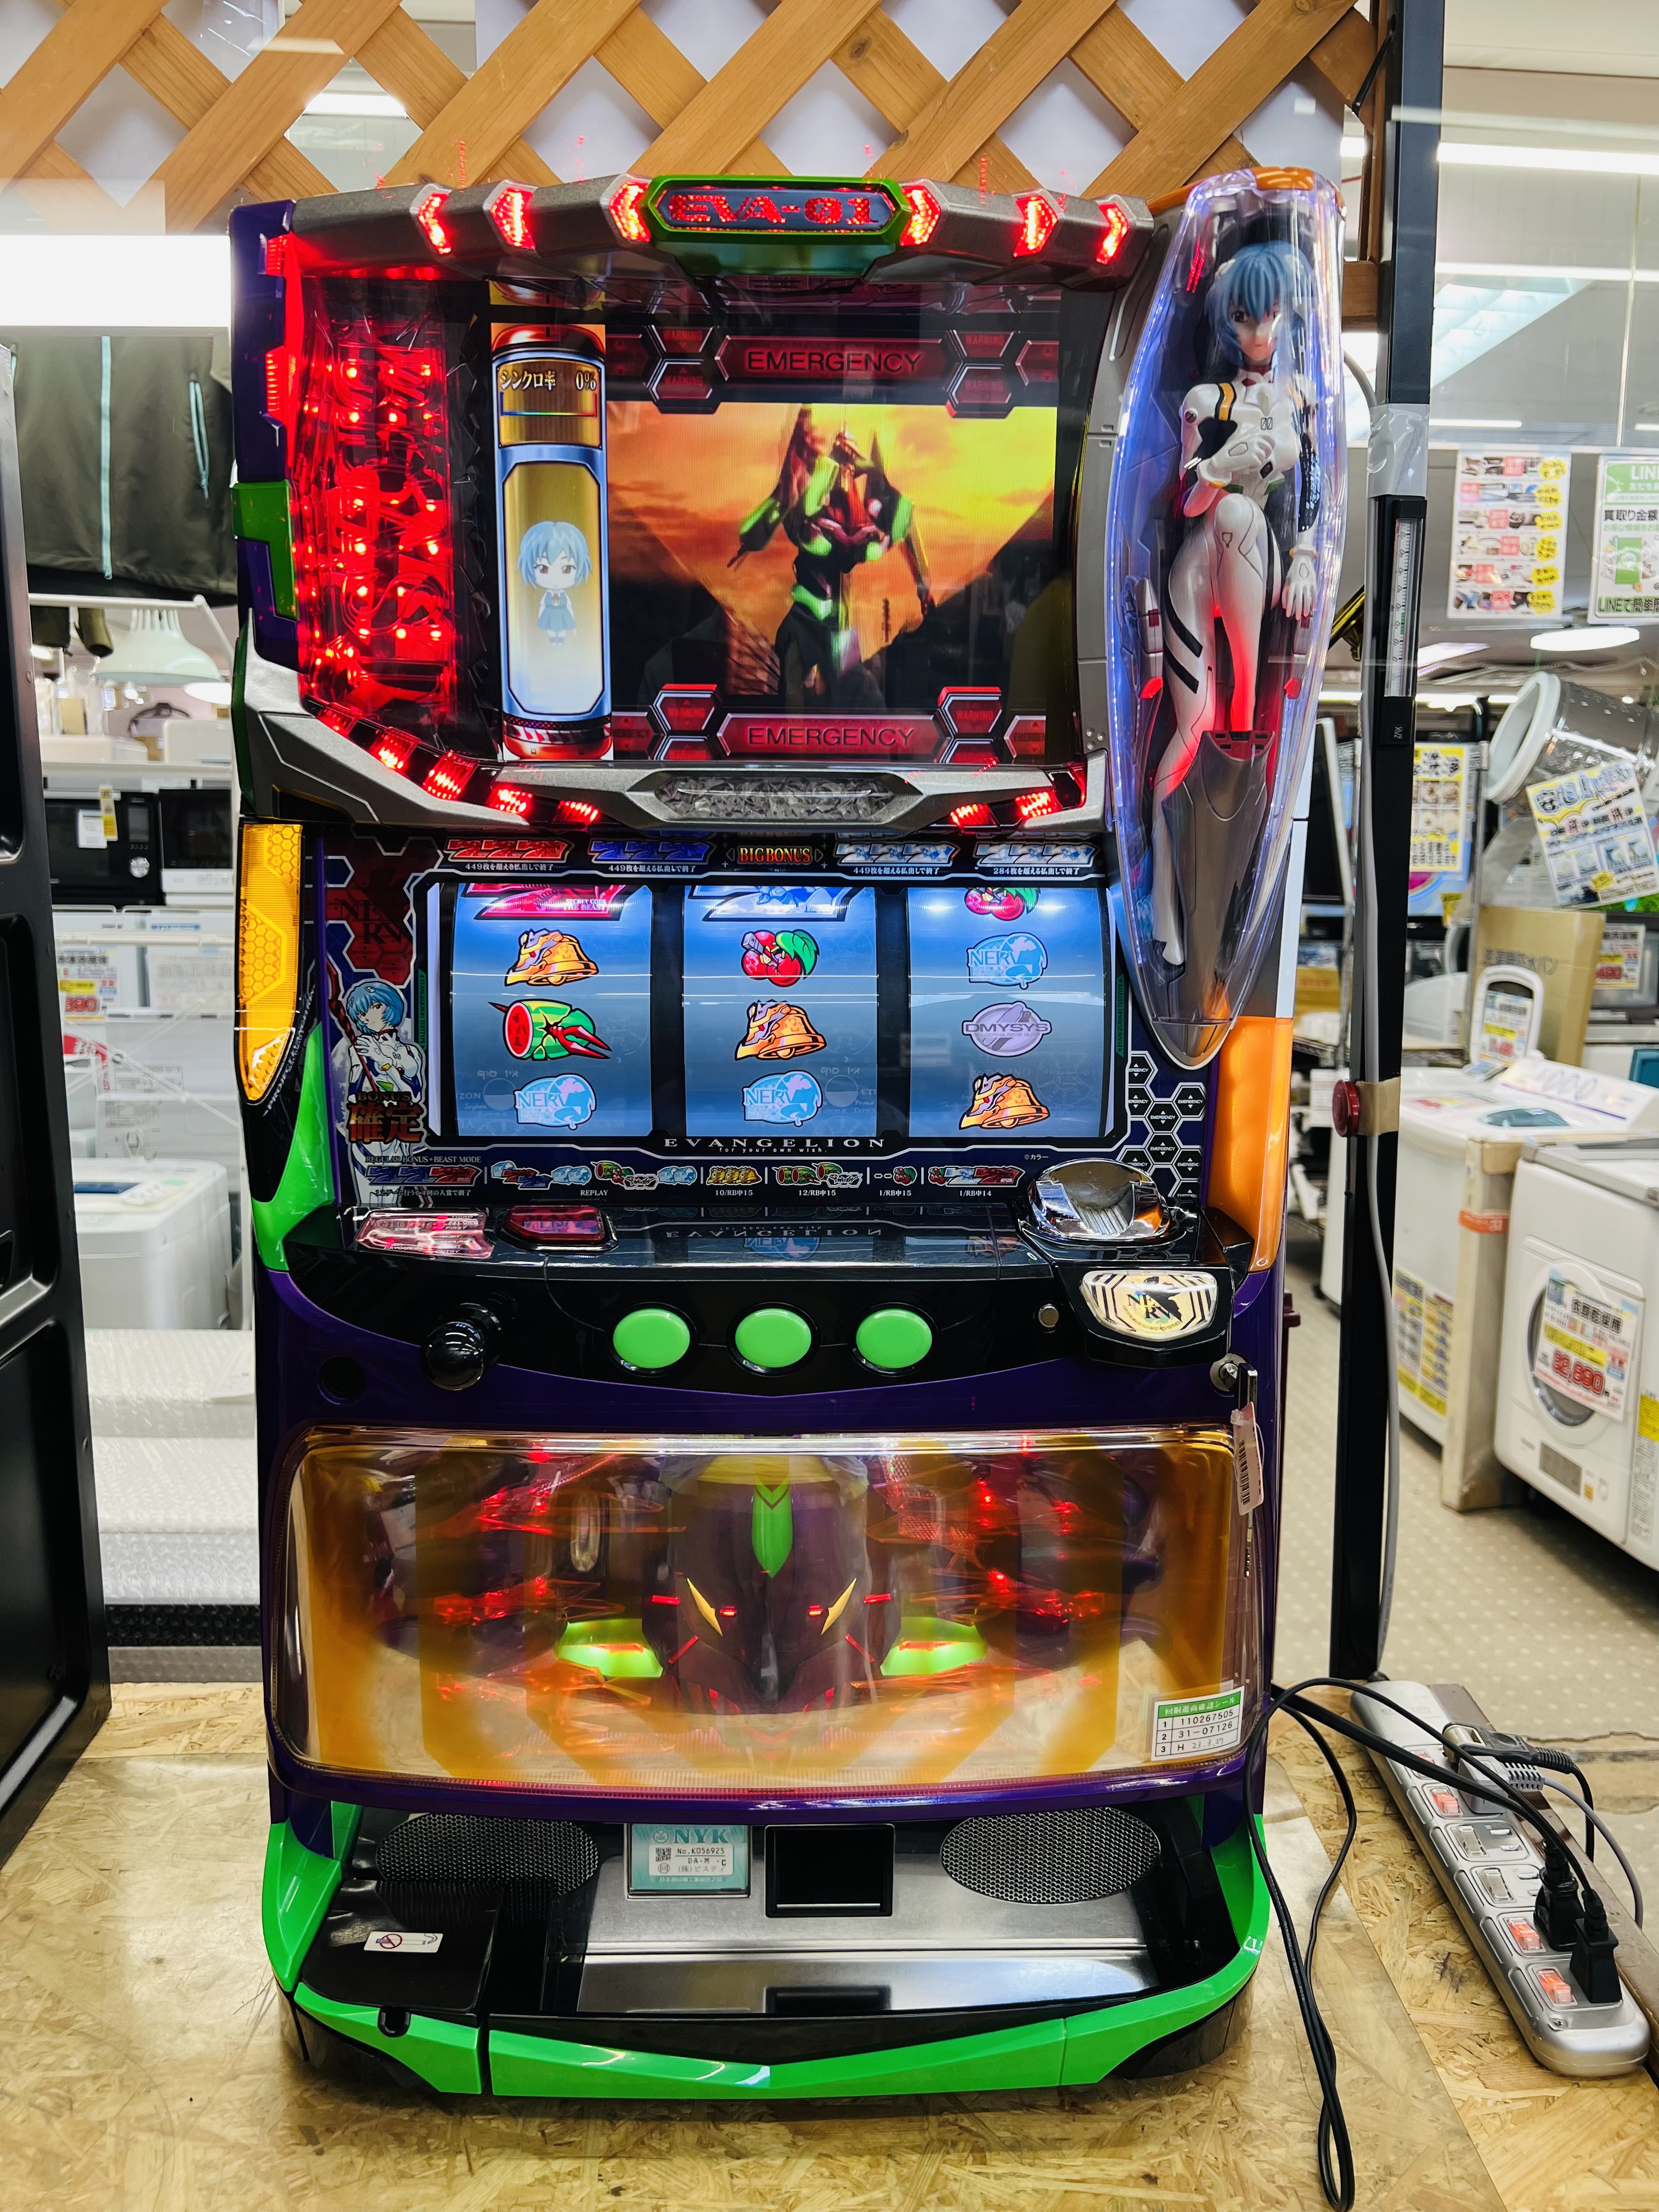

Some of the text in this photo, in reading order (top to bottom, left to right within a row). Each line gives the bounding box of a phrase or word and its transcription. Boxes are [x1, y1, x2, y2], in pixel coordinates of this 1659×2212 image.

[668, 194, 879, 225] EVA-01
[747, 351, 922, 373] EMERGENCY
[501, 370, 596, 391] シンクロ率 0%
[1632, 465, 1659, 480] LIN
[748, 727, 915, 746] EMERGENCY
[966, 1024, 1049, 1032] DMYSYS
[348, 1103, 422, 1143] 確定
[664, 1139, 884, 1147] EVANGELION
[1181, 1708, 1234, 1726] 110267505
[673, 1828, 729, 1844] NYK
